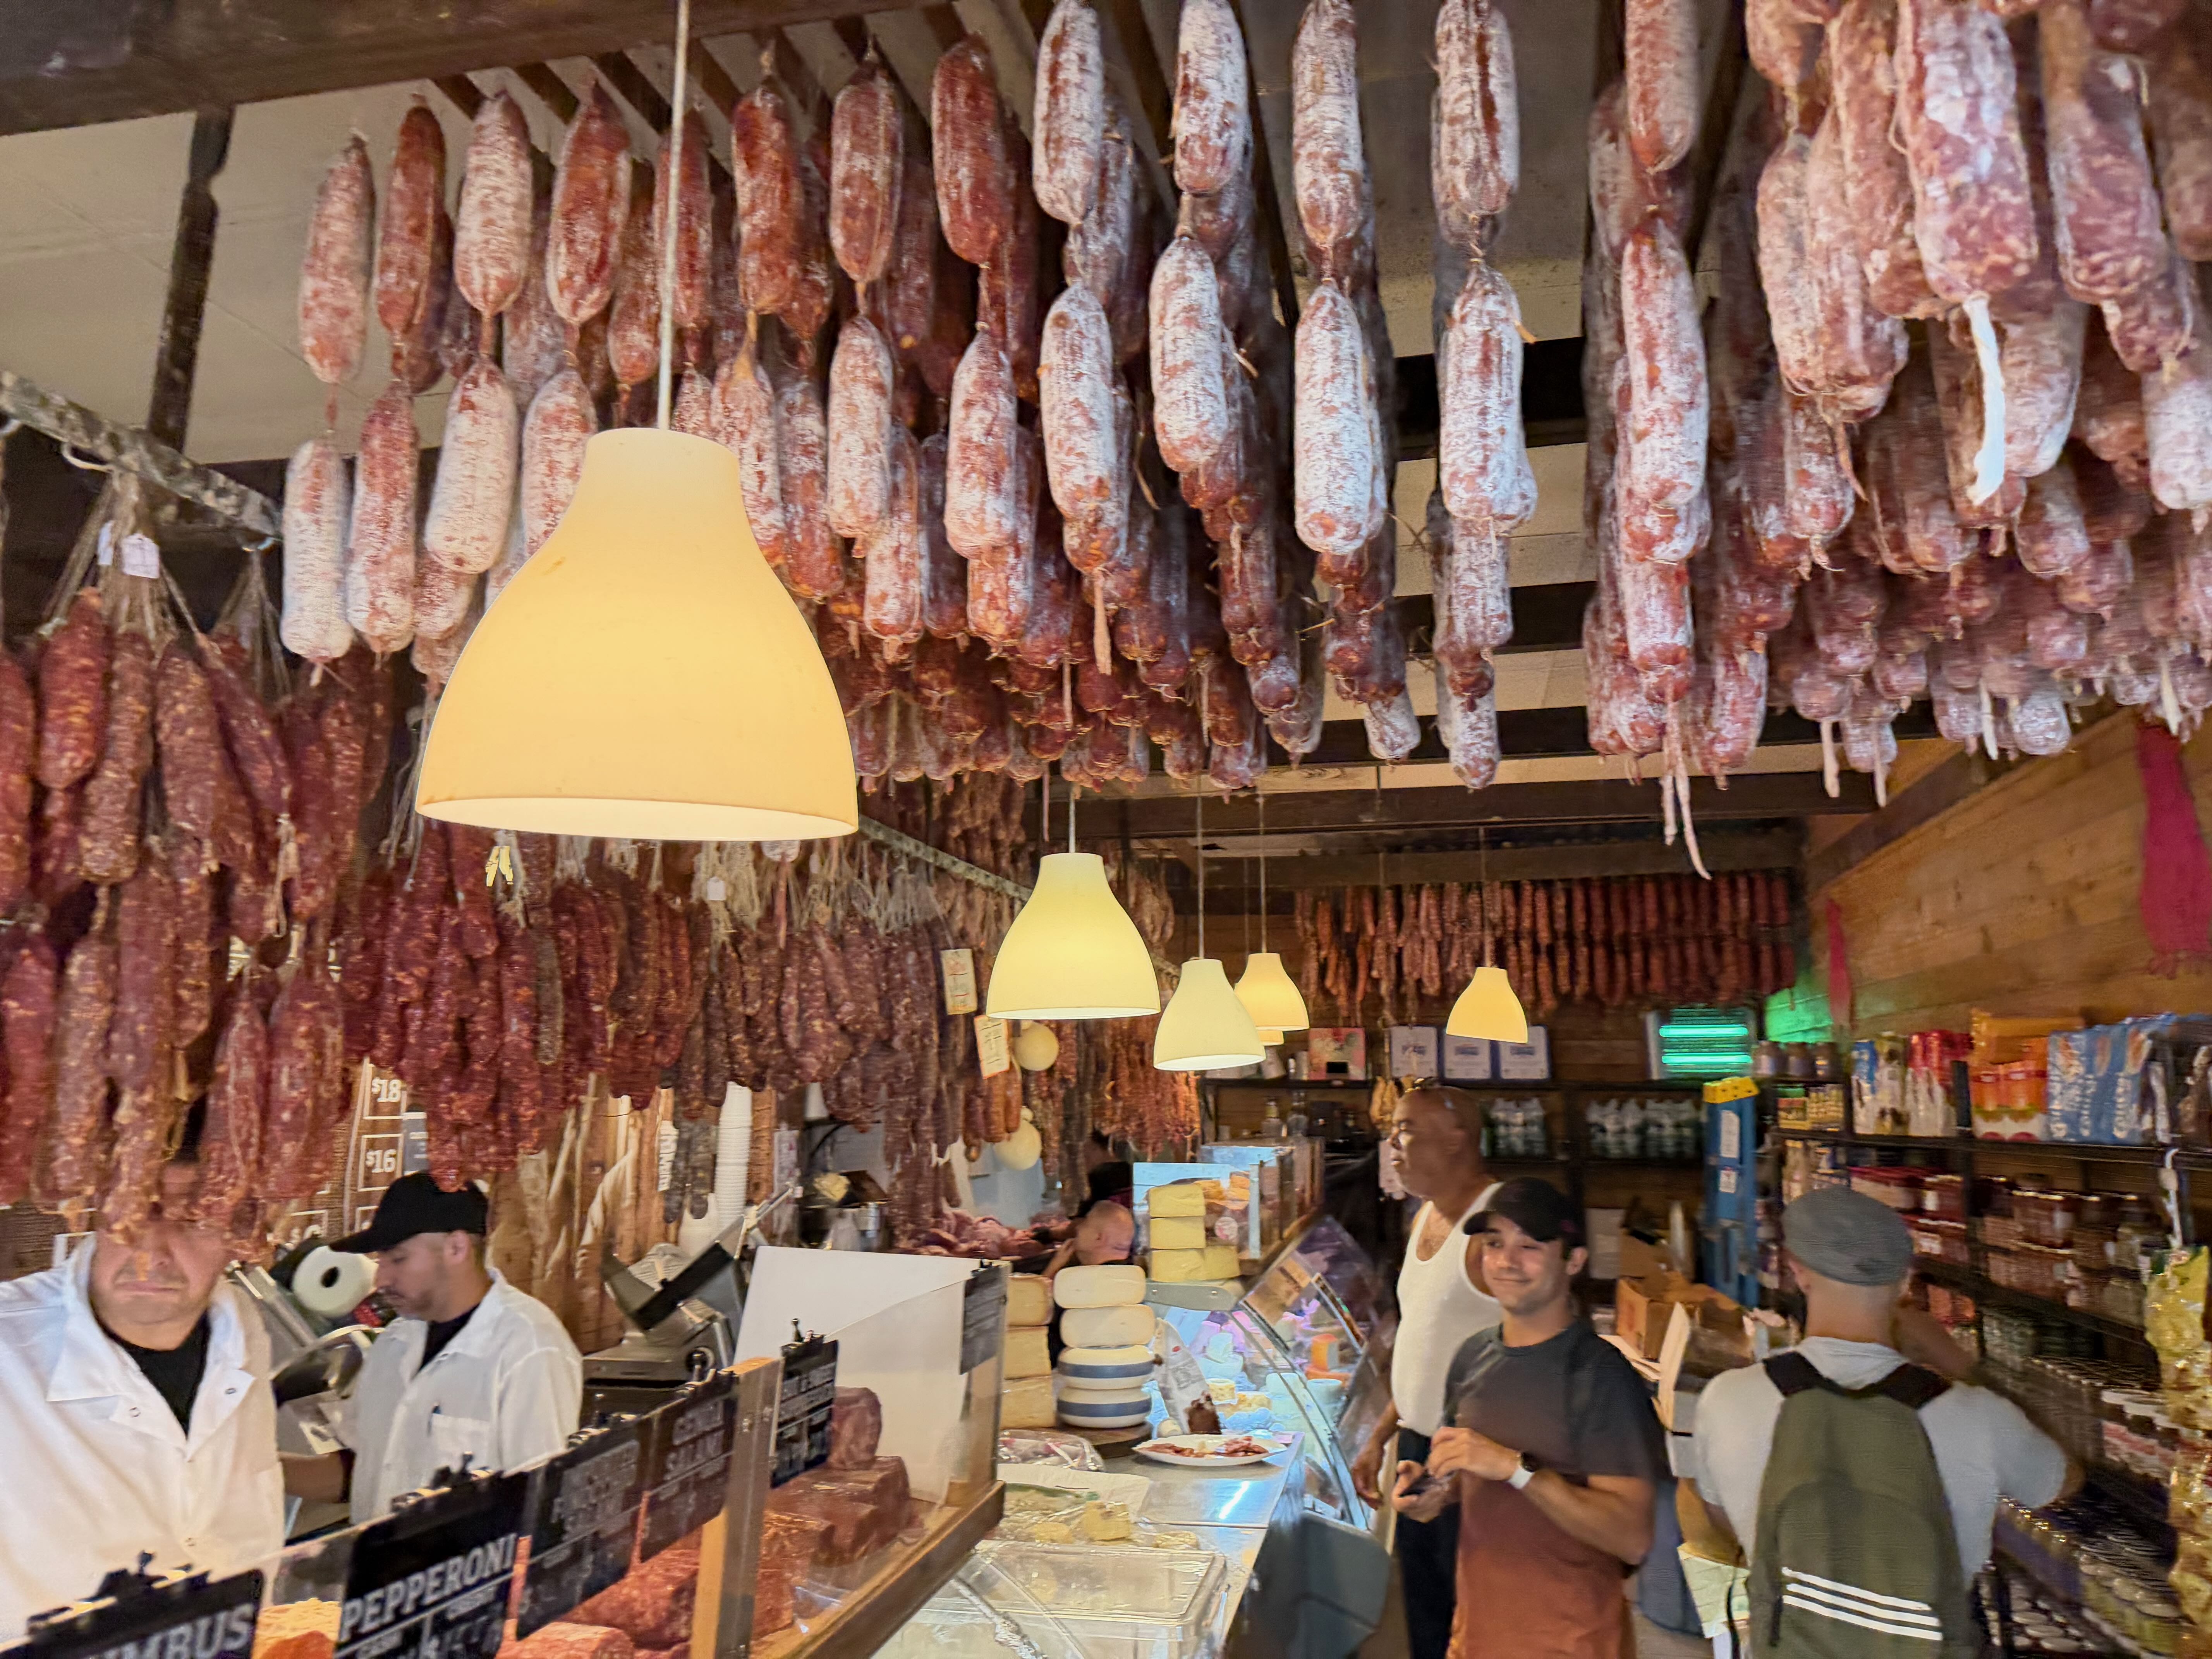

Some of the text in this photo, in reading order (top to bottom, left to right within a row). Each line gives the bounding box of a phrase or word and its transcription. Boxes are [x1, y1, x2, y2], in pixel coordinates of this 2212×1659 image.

[372, 1077, 402, 1102] $18
[366, 1149, 397, 1173] $16
[340, 1533, 517, 1642] PEPPERONI
